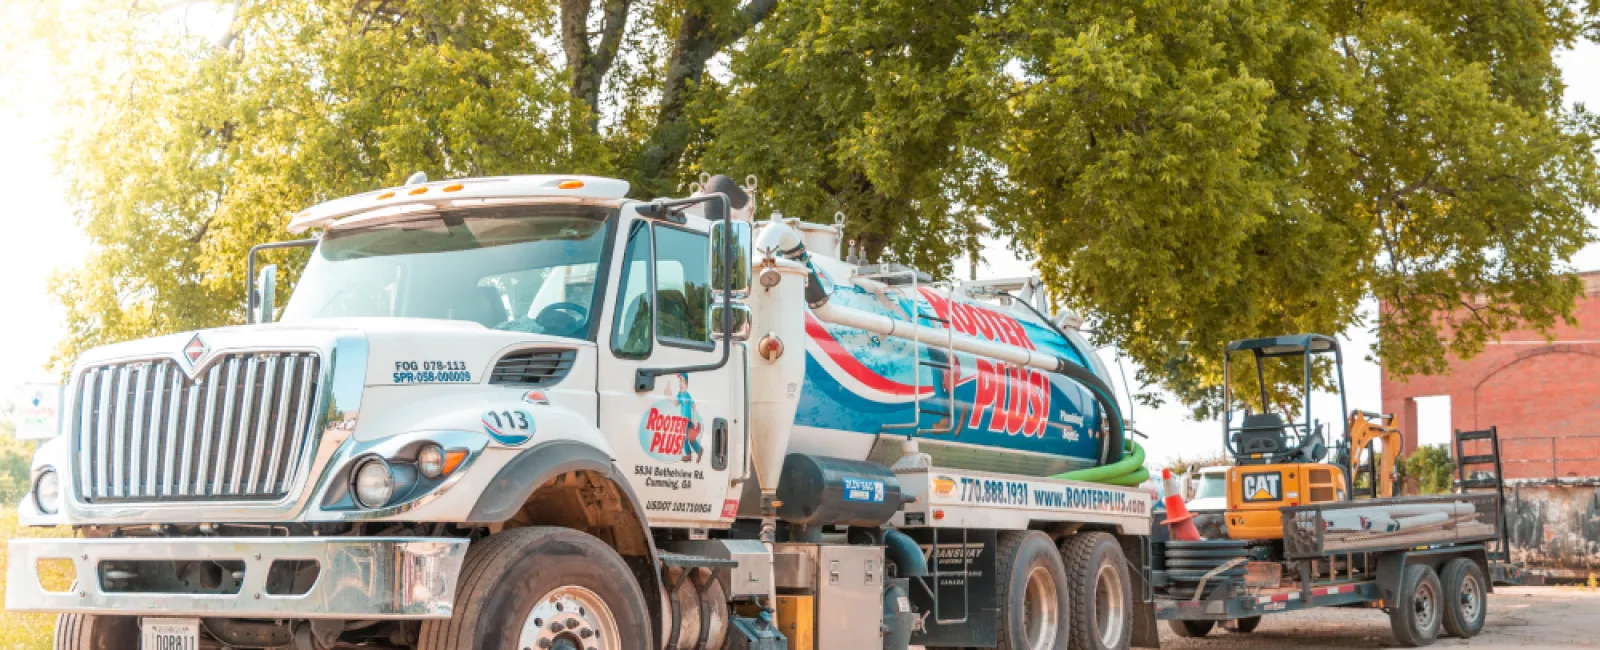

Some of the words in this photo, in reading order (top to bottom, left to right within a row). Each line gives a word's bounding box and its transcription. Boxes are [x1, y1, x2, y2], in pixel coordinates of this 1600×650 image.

[916, 286, 1036, 351] ROOTER
[395, 361, 418, 371] FOG
[423, 361, 466, 371] 078-113
[968, 358, 1050, 439] PLUS!
[488, 410, 529, 430] 113
[646, 407, 688, 434] ROOTER
[649, 431, 686, 456] PLUS!
[634, 465, 653, 476] 5834
[654, 467, 692, 479] Bethelview
[681, 480, 692, 489] GA
[960, 477, 1028, 505] 770.888.1931
[1034, 487, 1146, 514] www.ROOTERPLUS.com
[1244, 475, 1279, 500] CAT
[646, 501, 672, 512] USDOT
